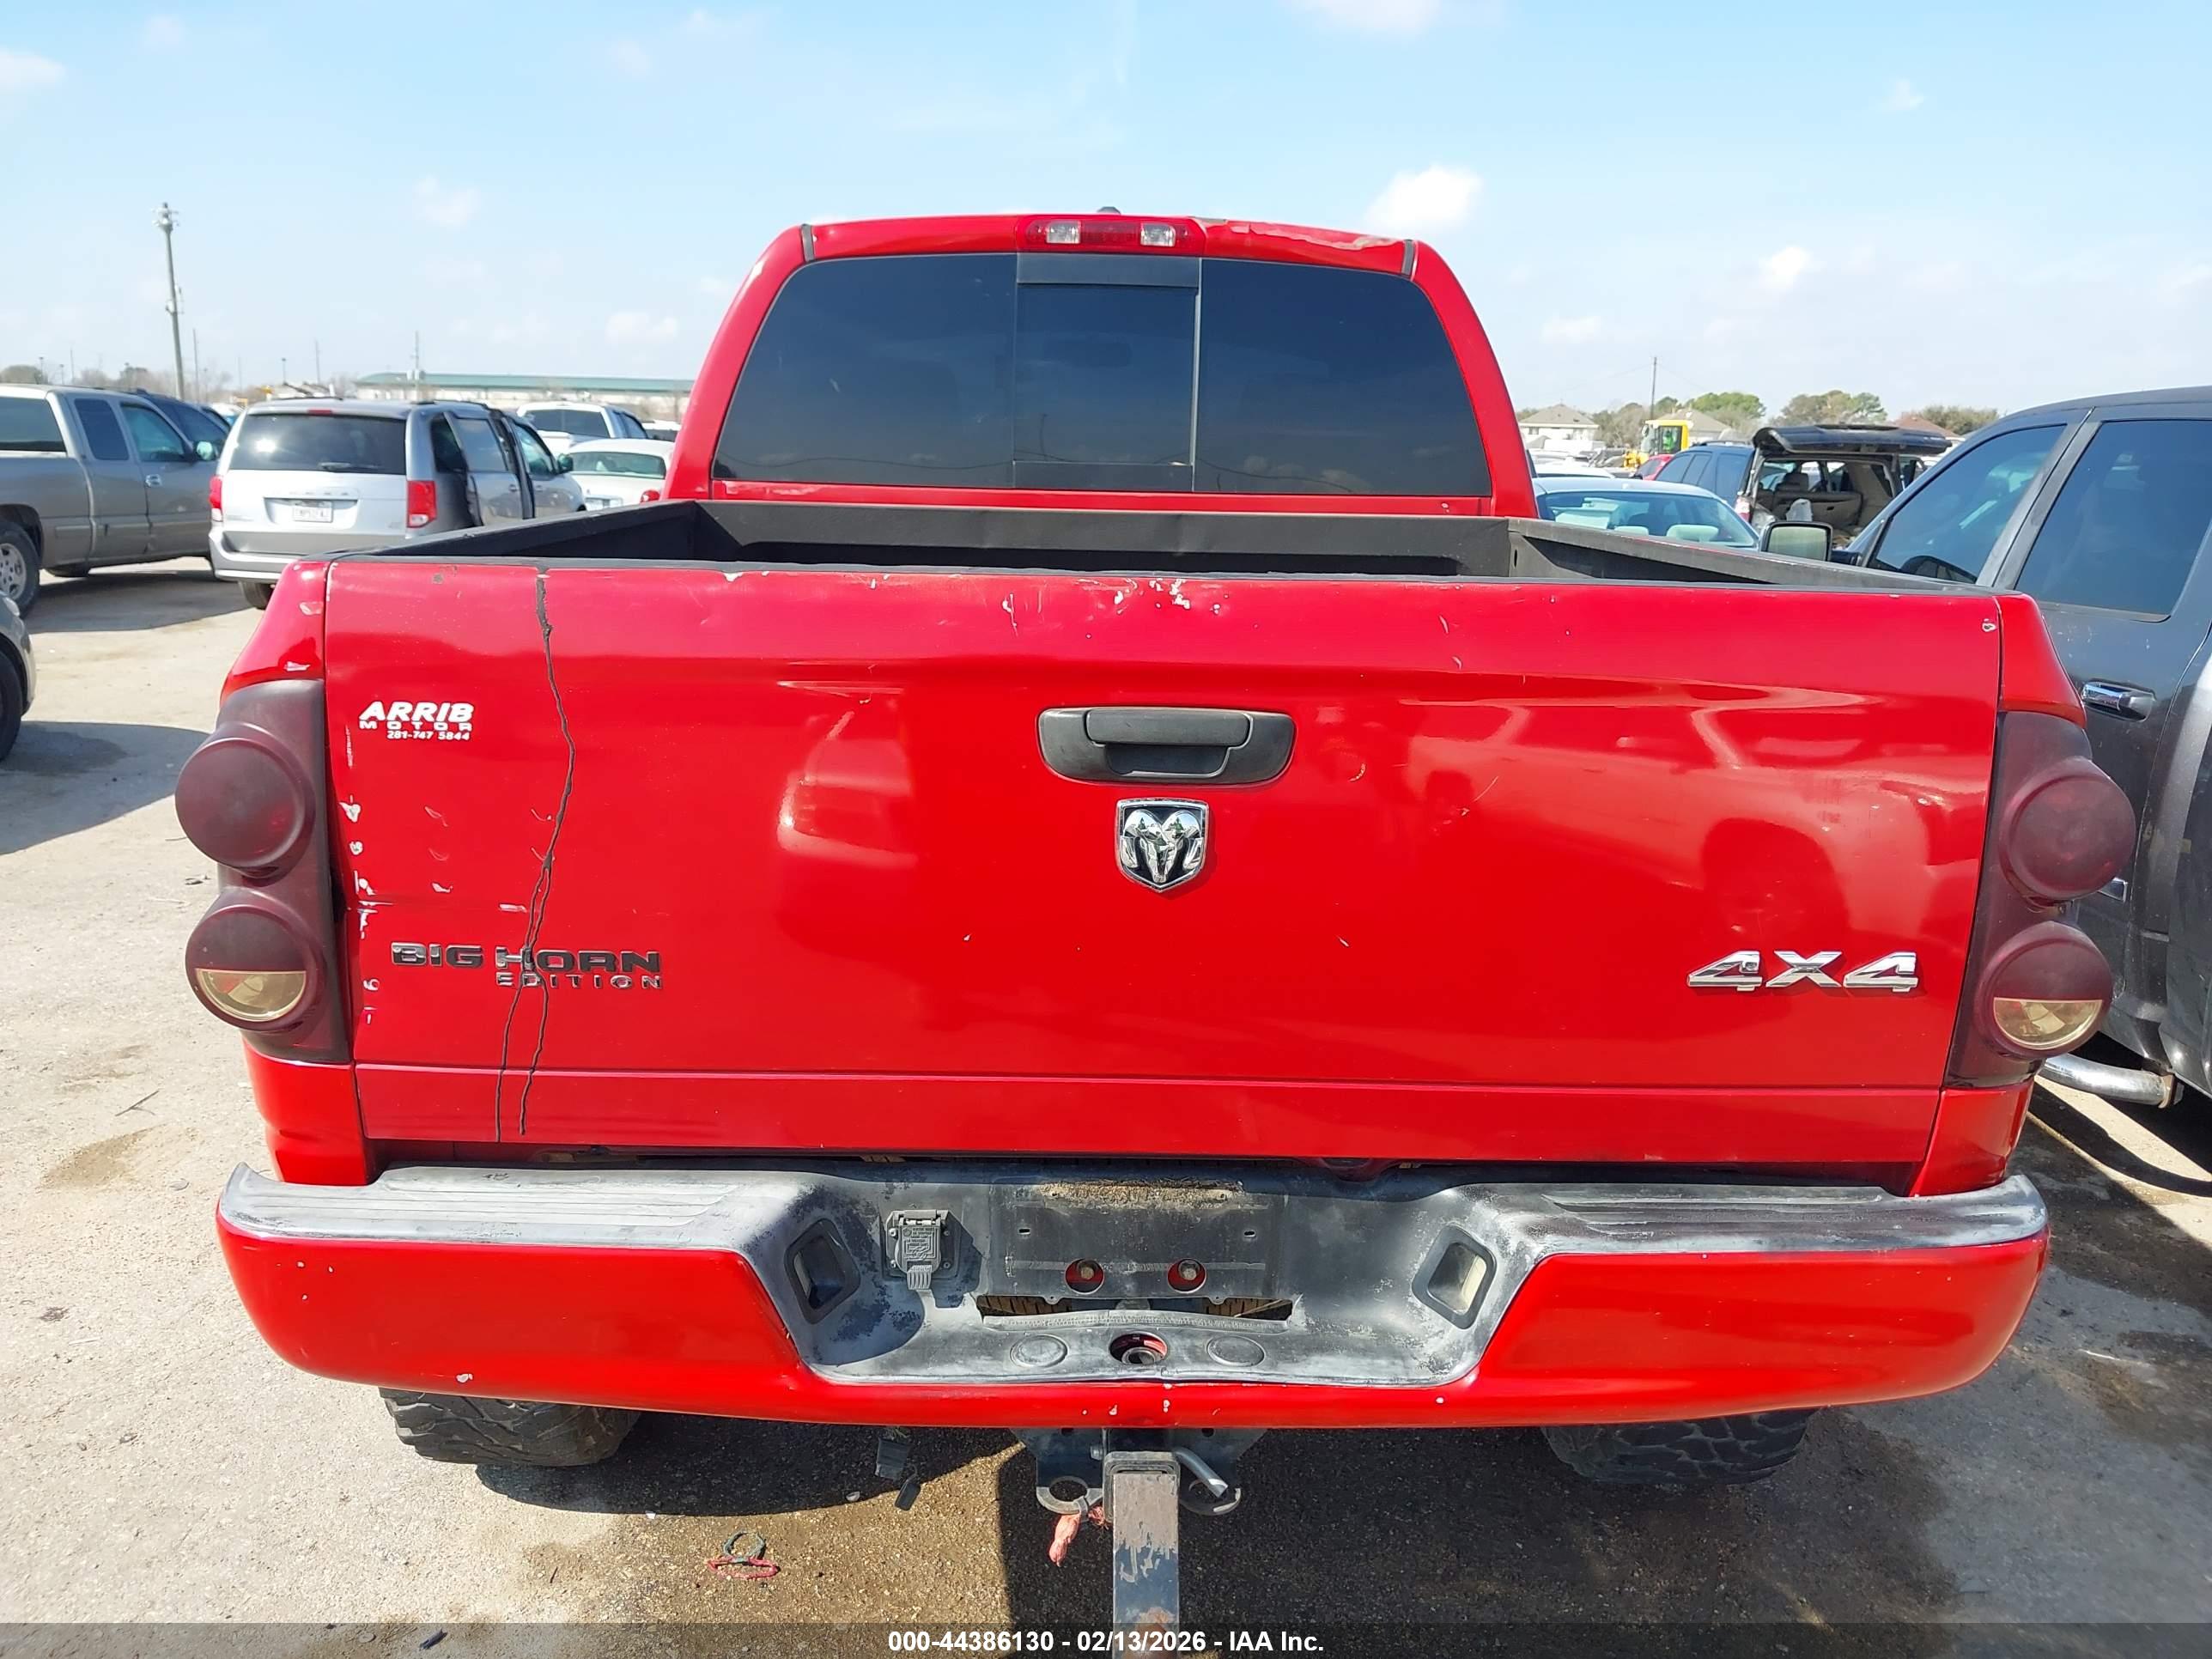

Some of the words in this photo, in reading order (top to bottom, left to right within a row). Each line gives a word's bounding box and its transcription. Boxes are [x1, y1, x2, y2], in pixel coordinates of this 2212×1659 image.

[359, 701, 474, 722] ARRIB
[359, 720, 472, 731] MOTOR
[387, 730, 434, 739] 281-747
[438, 732, 471, 740] 5844
[391, 942, 483, 968] BIG
[495, 945, 660, 973] HORN
[495, 971, 661, 988] EDITION
[1686, 950, 1919, 993] 4X4
